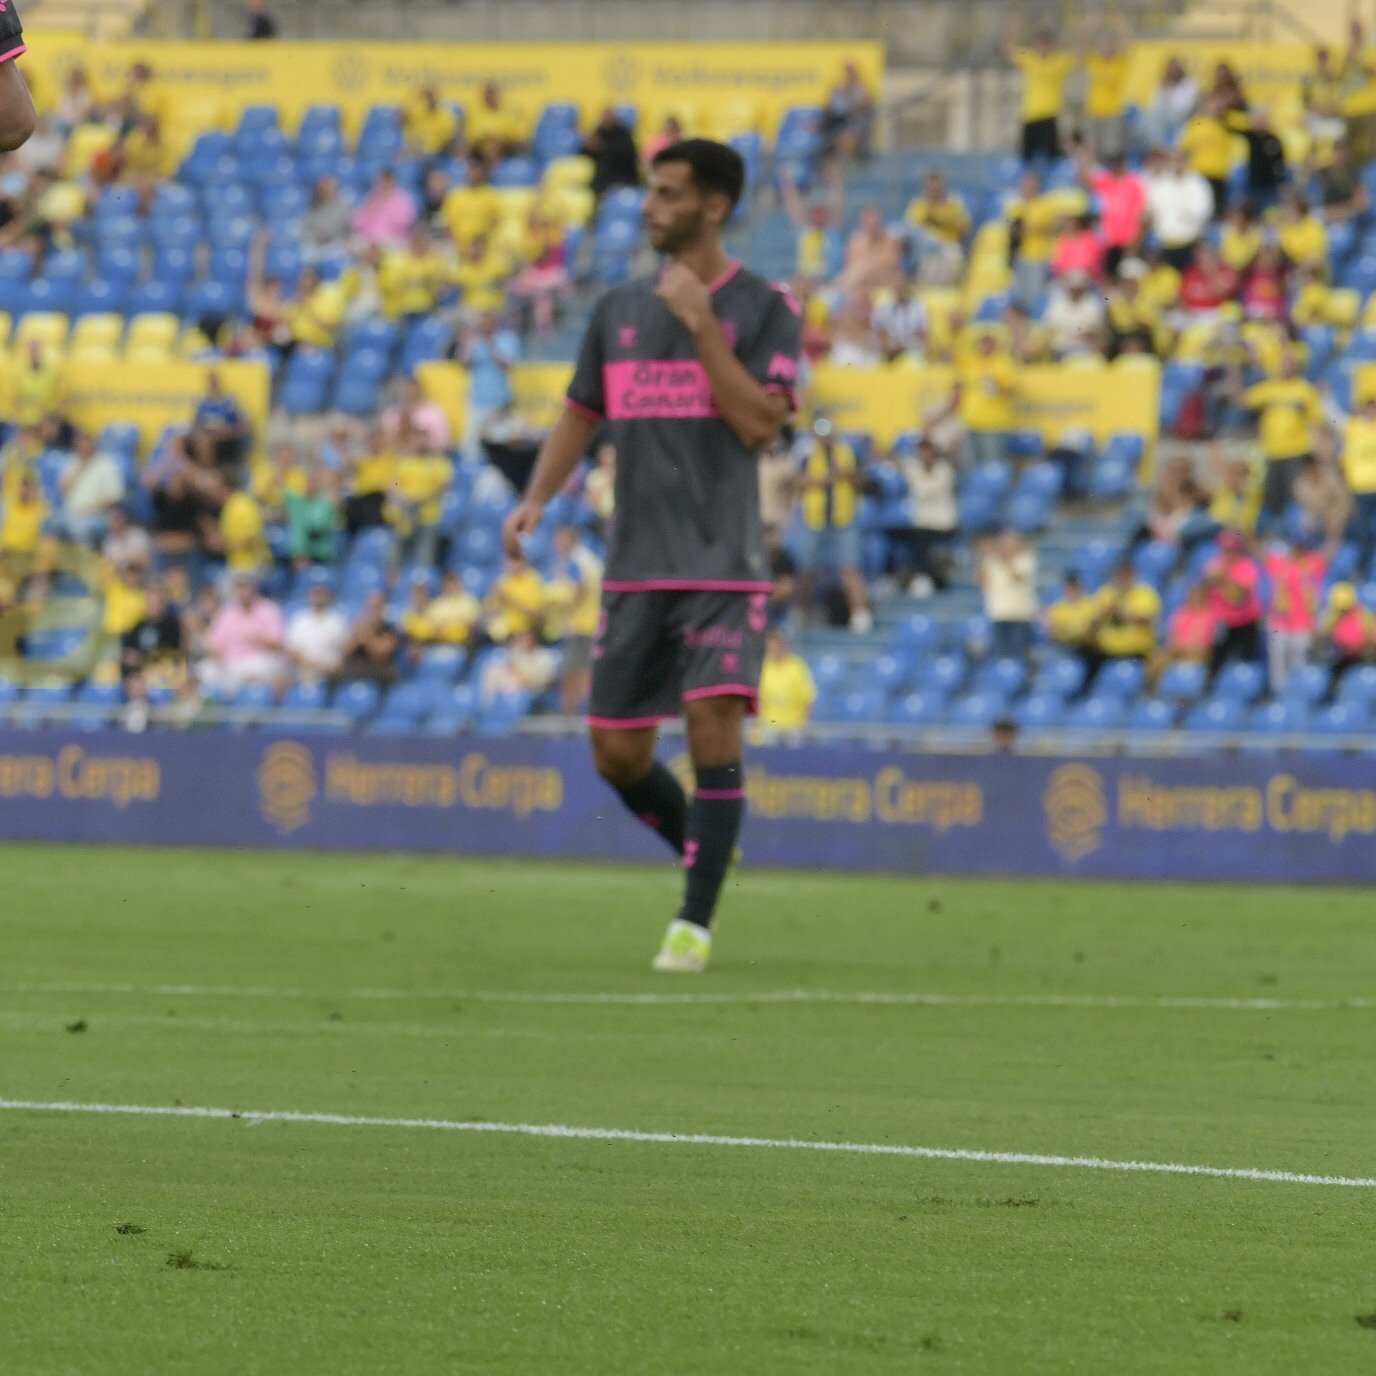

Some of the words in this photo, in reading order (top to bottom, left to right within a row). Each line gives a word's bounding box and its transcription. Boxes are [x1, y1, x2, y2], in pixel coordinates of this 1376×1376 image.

[57, 743, 161, 808] Cerpa
[324, 753, 456, 807] Herrera
[459, 752, 563, 820] Cerpa
[875, 766, 984, 835] Cerpa
[1117, 773, 1263, 834] Herrera
